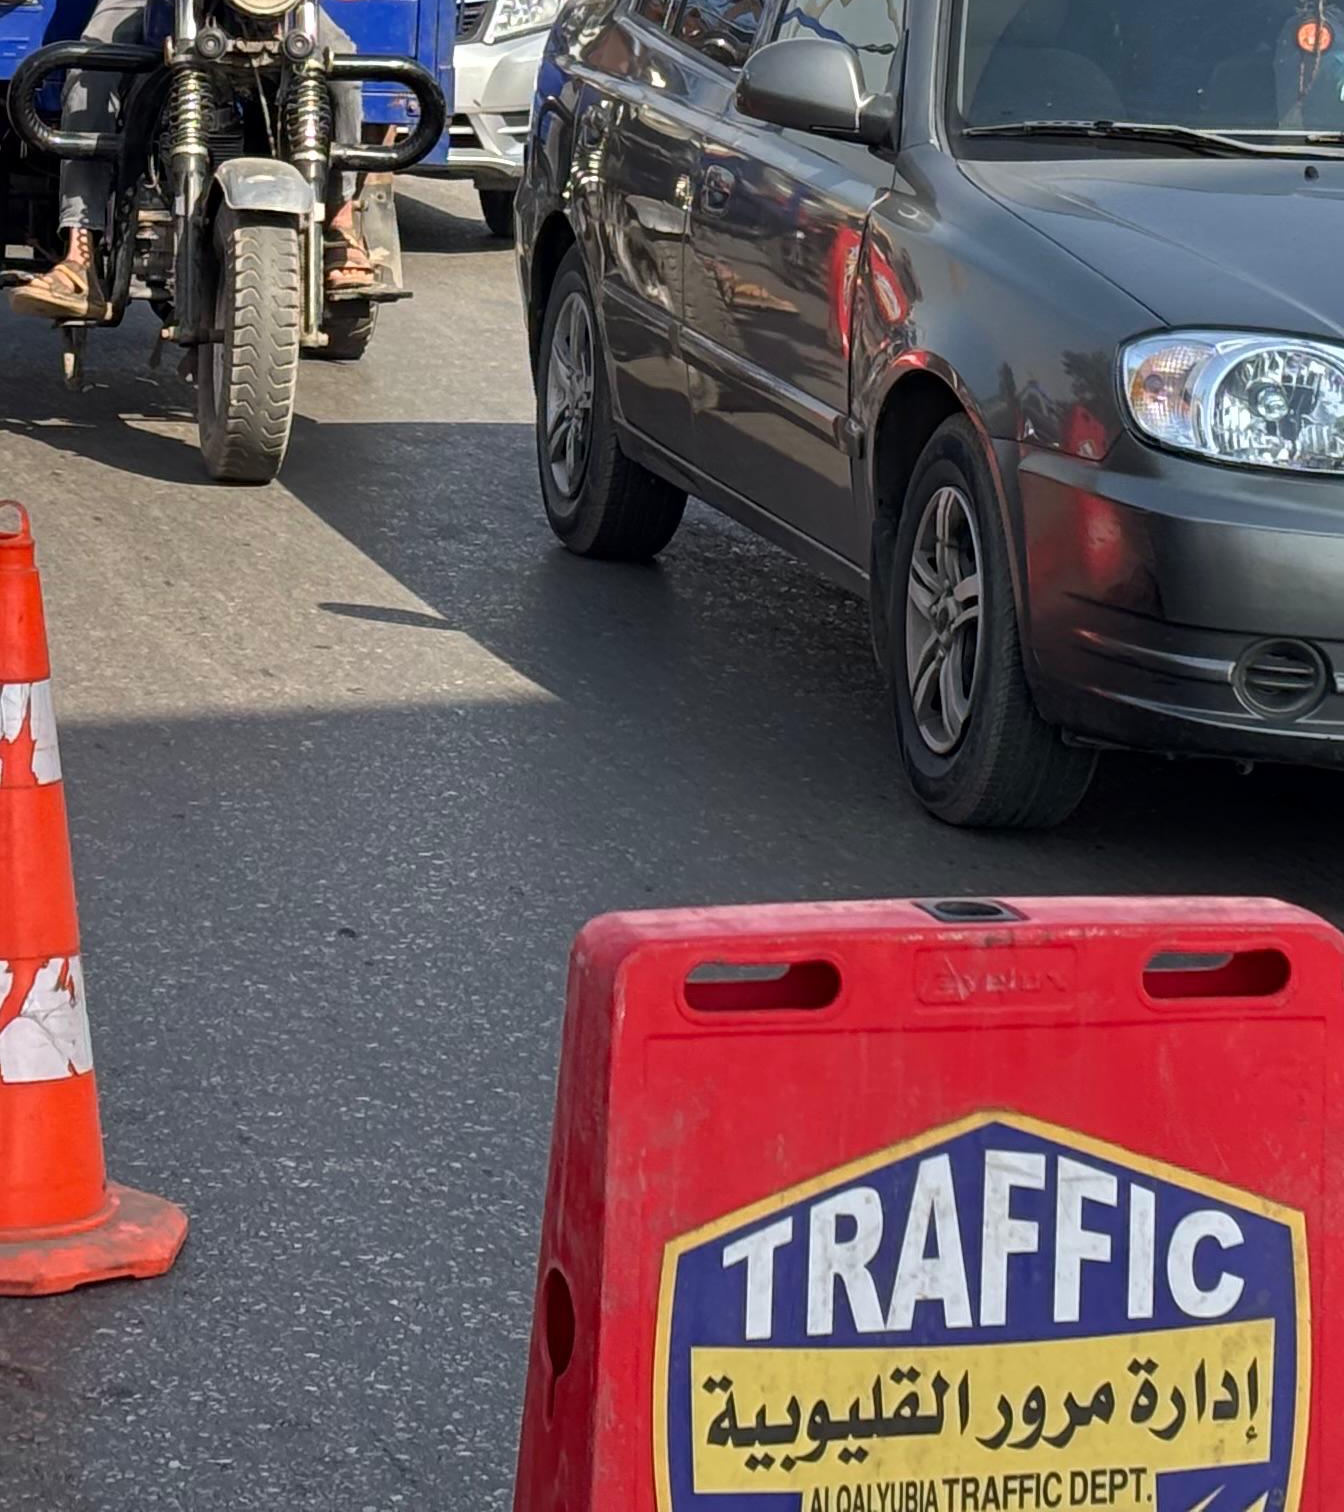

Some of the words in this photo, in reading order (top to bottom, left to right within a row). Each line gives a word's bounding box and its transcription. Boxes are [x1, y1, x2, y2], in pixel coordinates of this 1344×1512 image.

[721, 1149, 1247, 1341] TRAFFIC
[701, 1364, 971, 1474] القليوبية
[974, 1381, 1117, 1451] مرور
[1126, 1357, 1259, 1442] إدارة
[942, 1471, 1063, 1512] TRAFFIC
[1069, 1467, 1154, 1507] DEPT.
